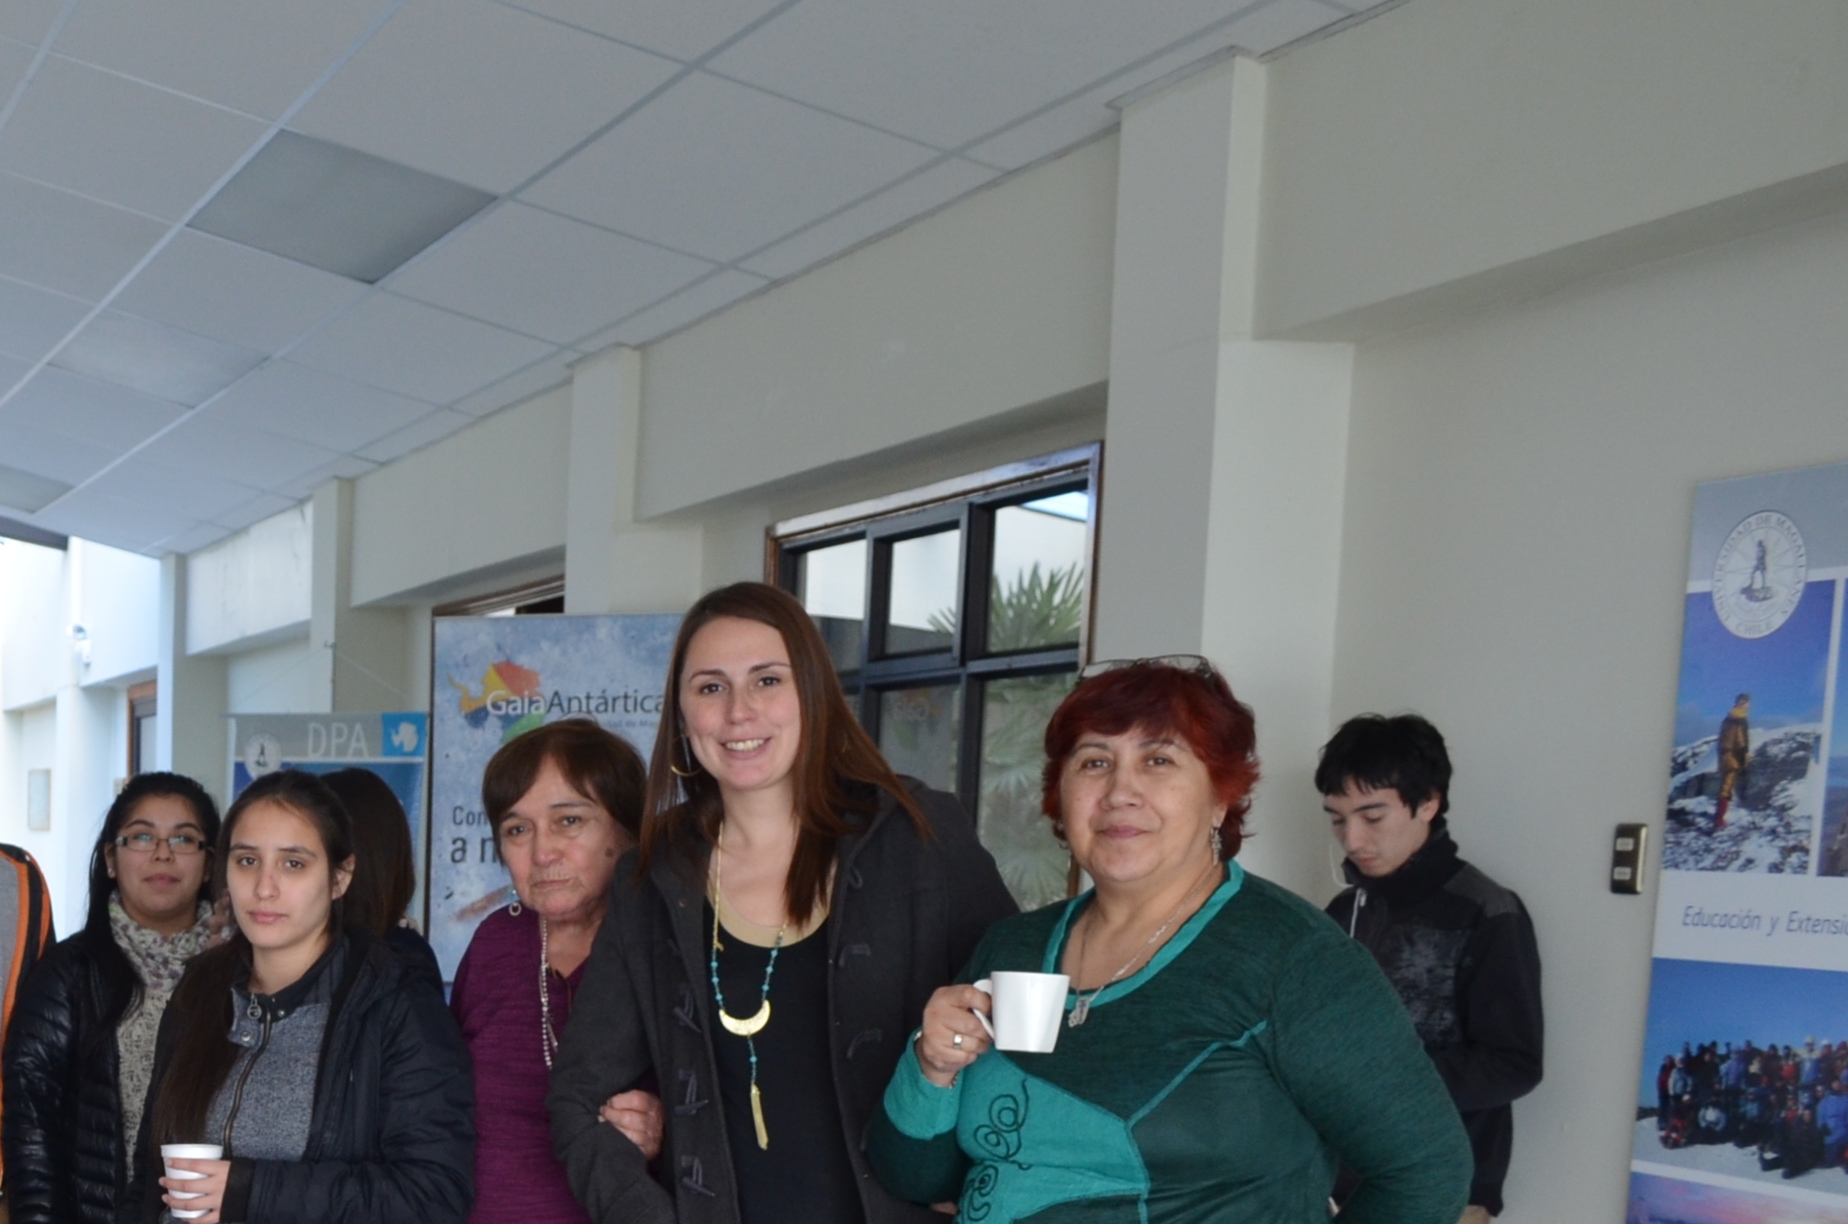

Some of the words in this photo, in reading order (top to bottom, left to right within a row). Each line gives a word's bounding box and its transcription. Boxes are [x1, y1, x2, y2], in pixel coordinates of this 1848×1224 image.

[308, 722, 369, 757] DPA
[451, 837, 467, 864] a
[1682, 905, 1761, 931] Educación
[1766, 915, 1780, 937] y
